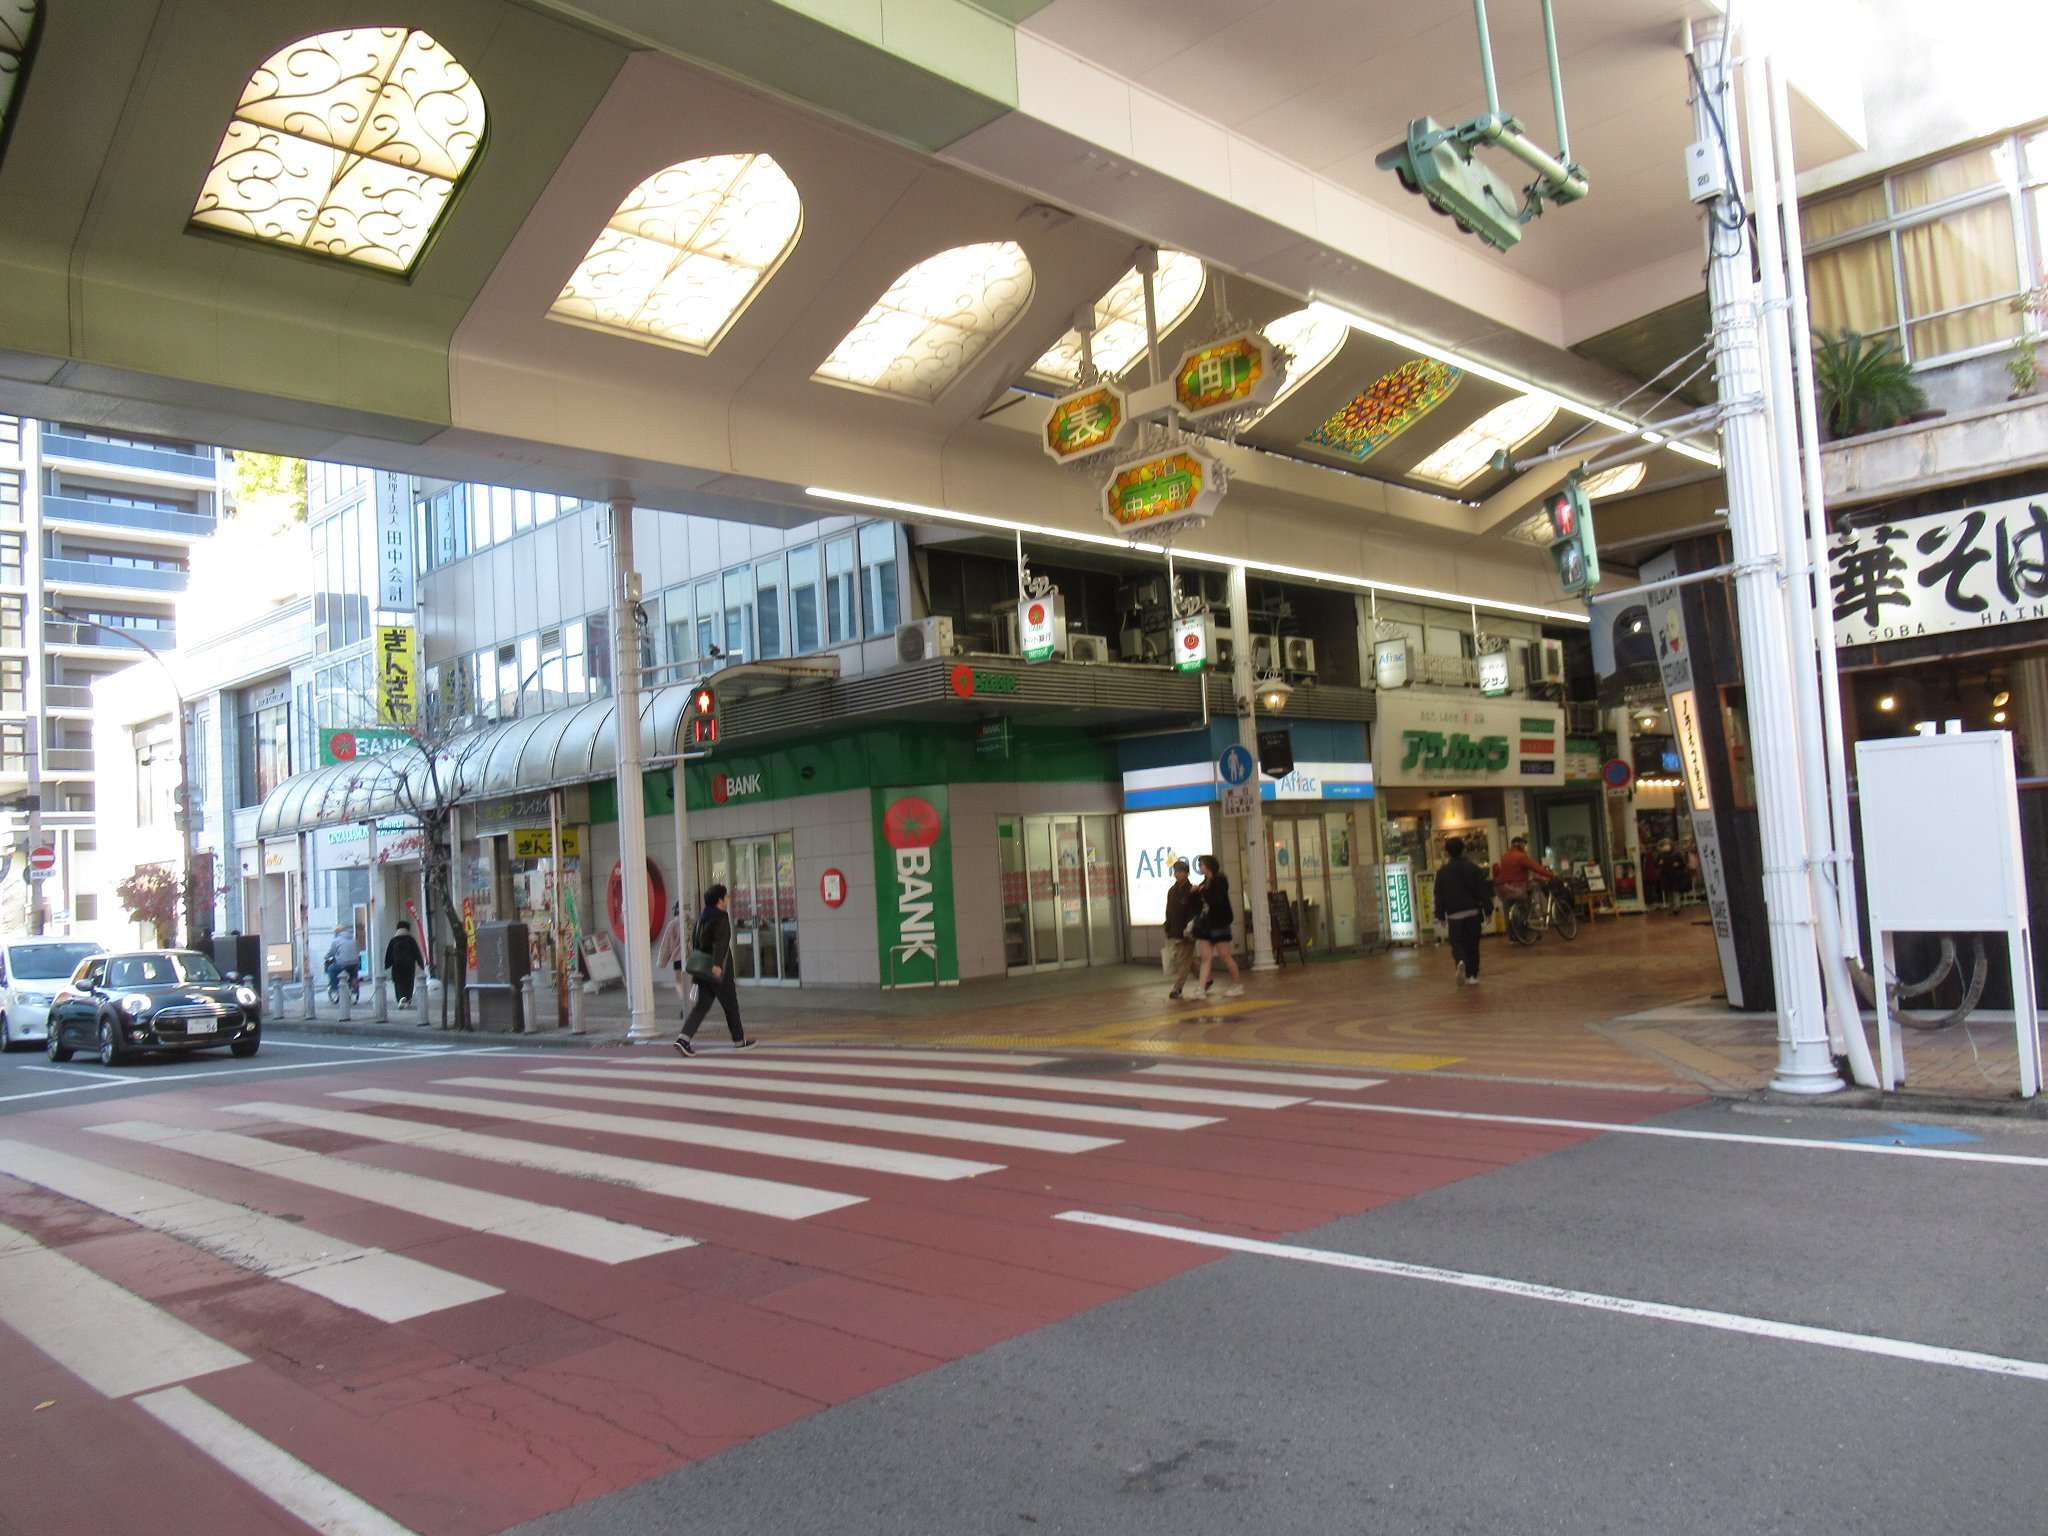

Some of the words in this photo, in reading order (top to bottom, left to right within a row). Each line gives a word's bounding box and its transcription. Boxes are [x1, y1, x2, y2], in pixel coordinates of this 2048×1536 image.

[1199, 353, 1239, 396] 町
[1067, 406, 1104, 446] 表
[1868, 623, 1926, 642] SOBA
[355, 737, 412, 756] BANK
[726, 773, 761, 797] BANK
[896, 847, 935, 964] BANK
